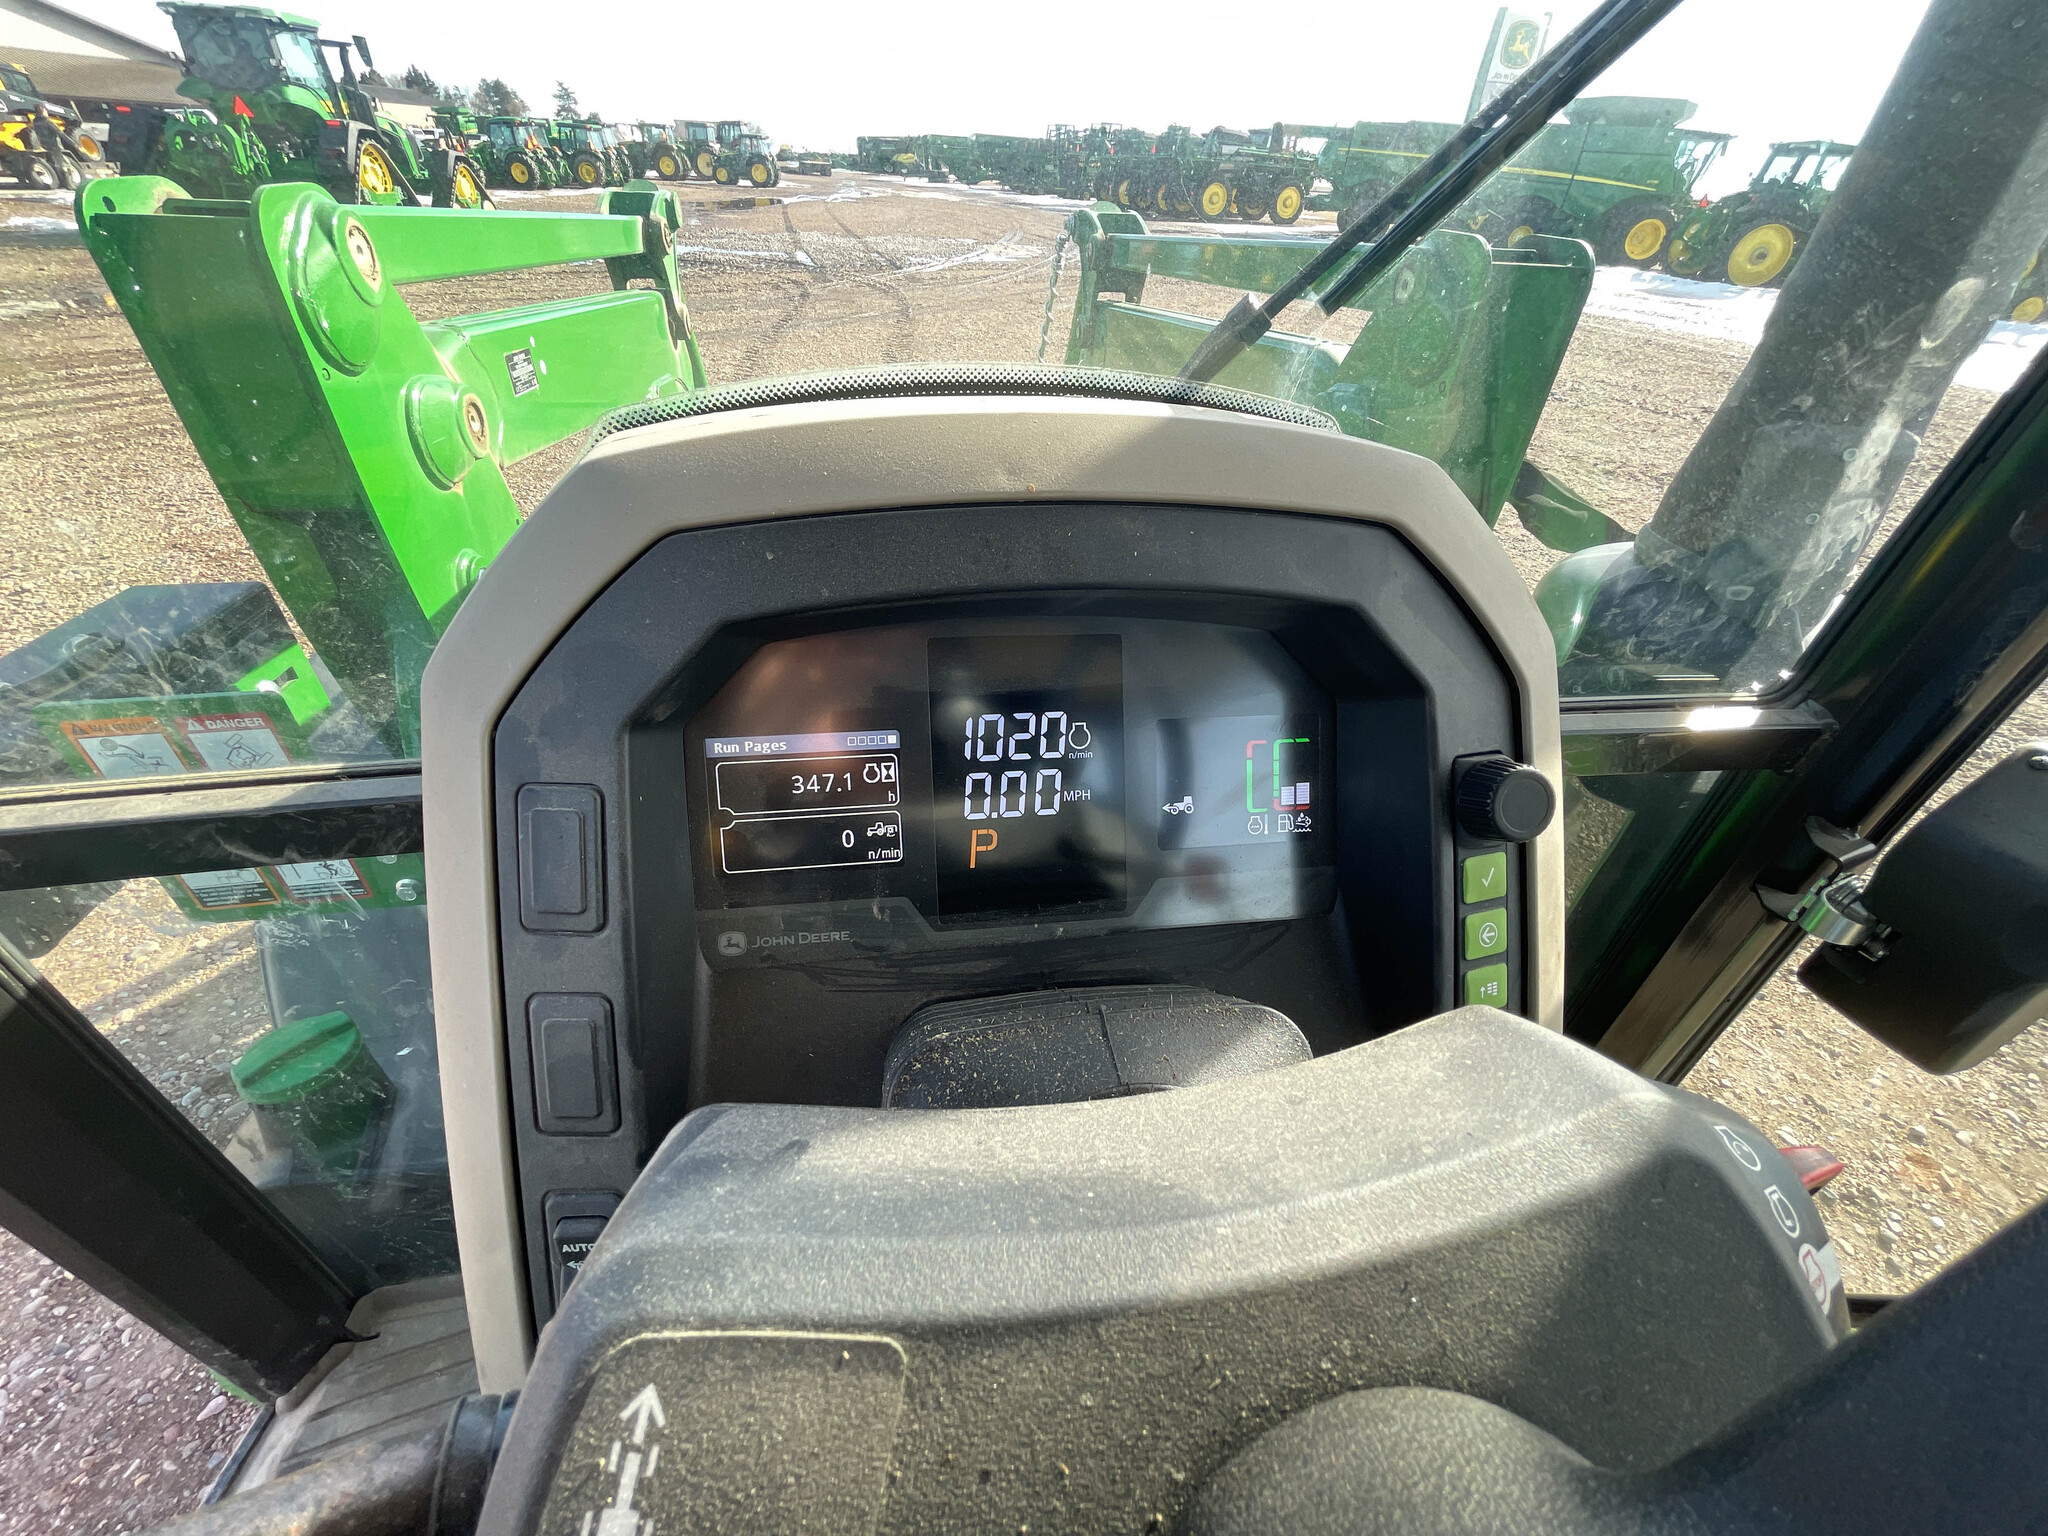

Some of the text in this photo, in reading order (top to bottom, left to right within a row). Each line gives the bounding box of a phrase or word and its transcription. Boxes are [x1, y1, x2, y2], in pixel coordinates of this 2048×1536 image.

[204, 717, 265, 730] DANGER
[964, 711, 1067, 762] 1020
[713, 740, 787, 754] Run Pages
[1068, 750, 1093, 760] n/min
[791, 772, 852, 795] 347.1
[888, 790, 896, 802] h
[964, 768, 1062, 820] 0.00
[1063, 789, 1091, 802] MPH
[841, 829, 855, 848] 0
[868, 847, 901, 860] n/min
[969, 828, 998, 869] P
[751, 935, 795, 948] JOHN
